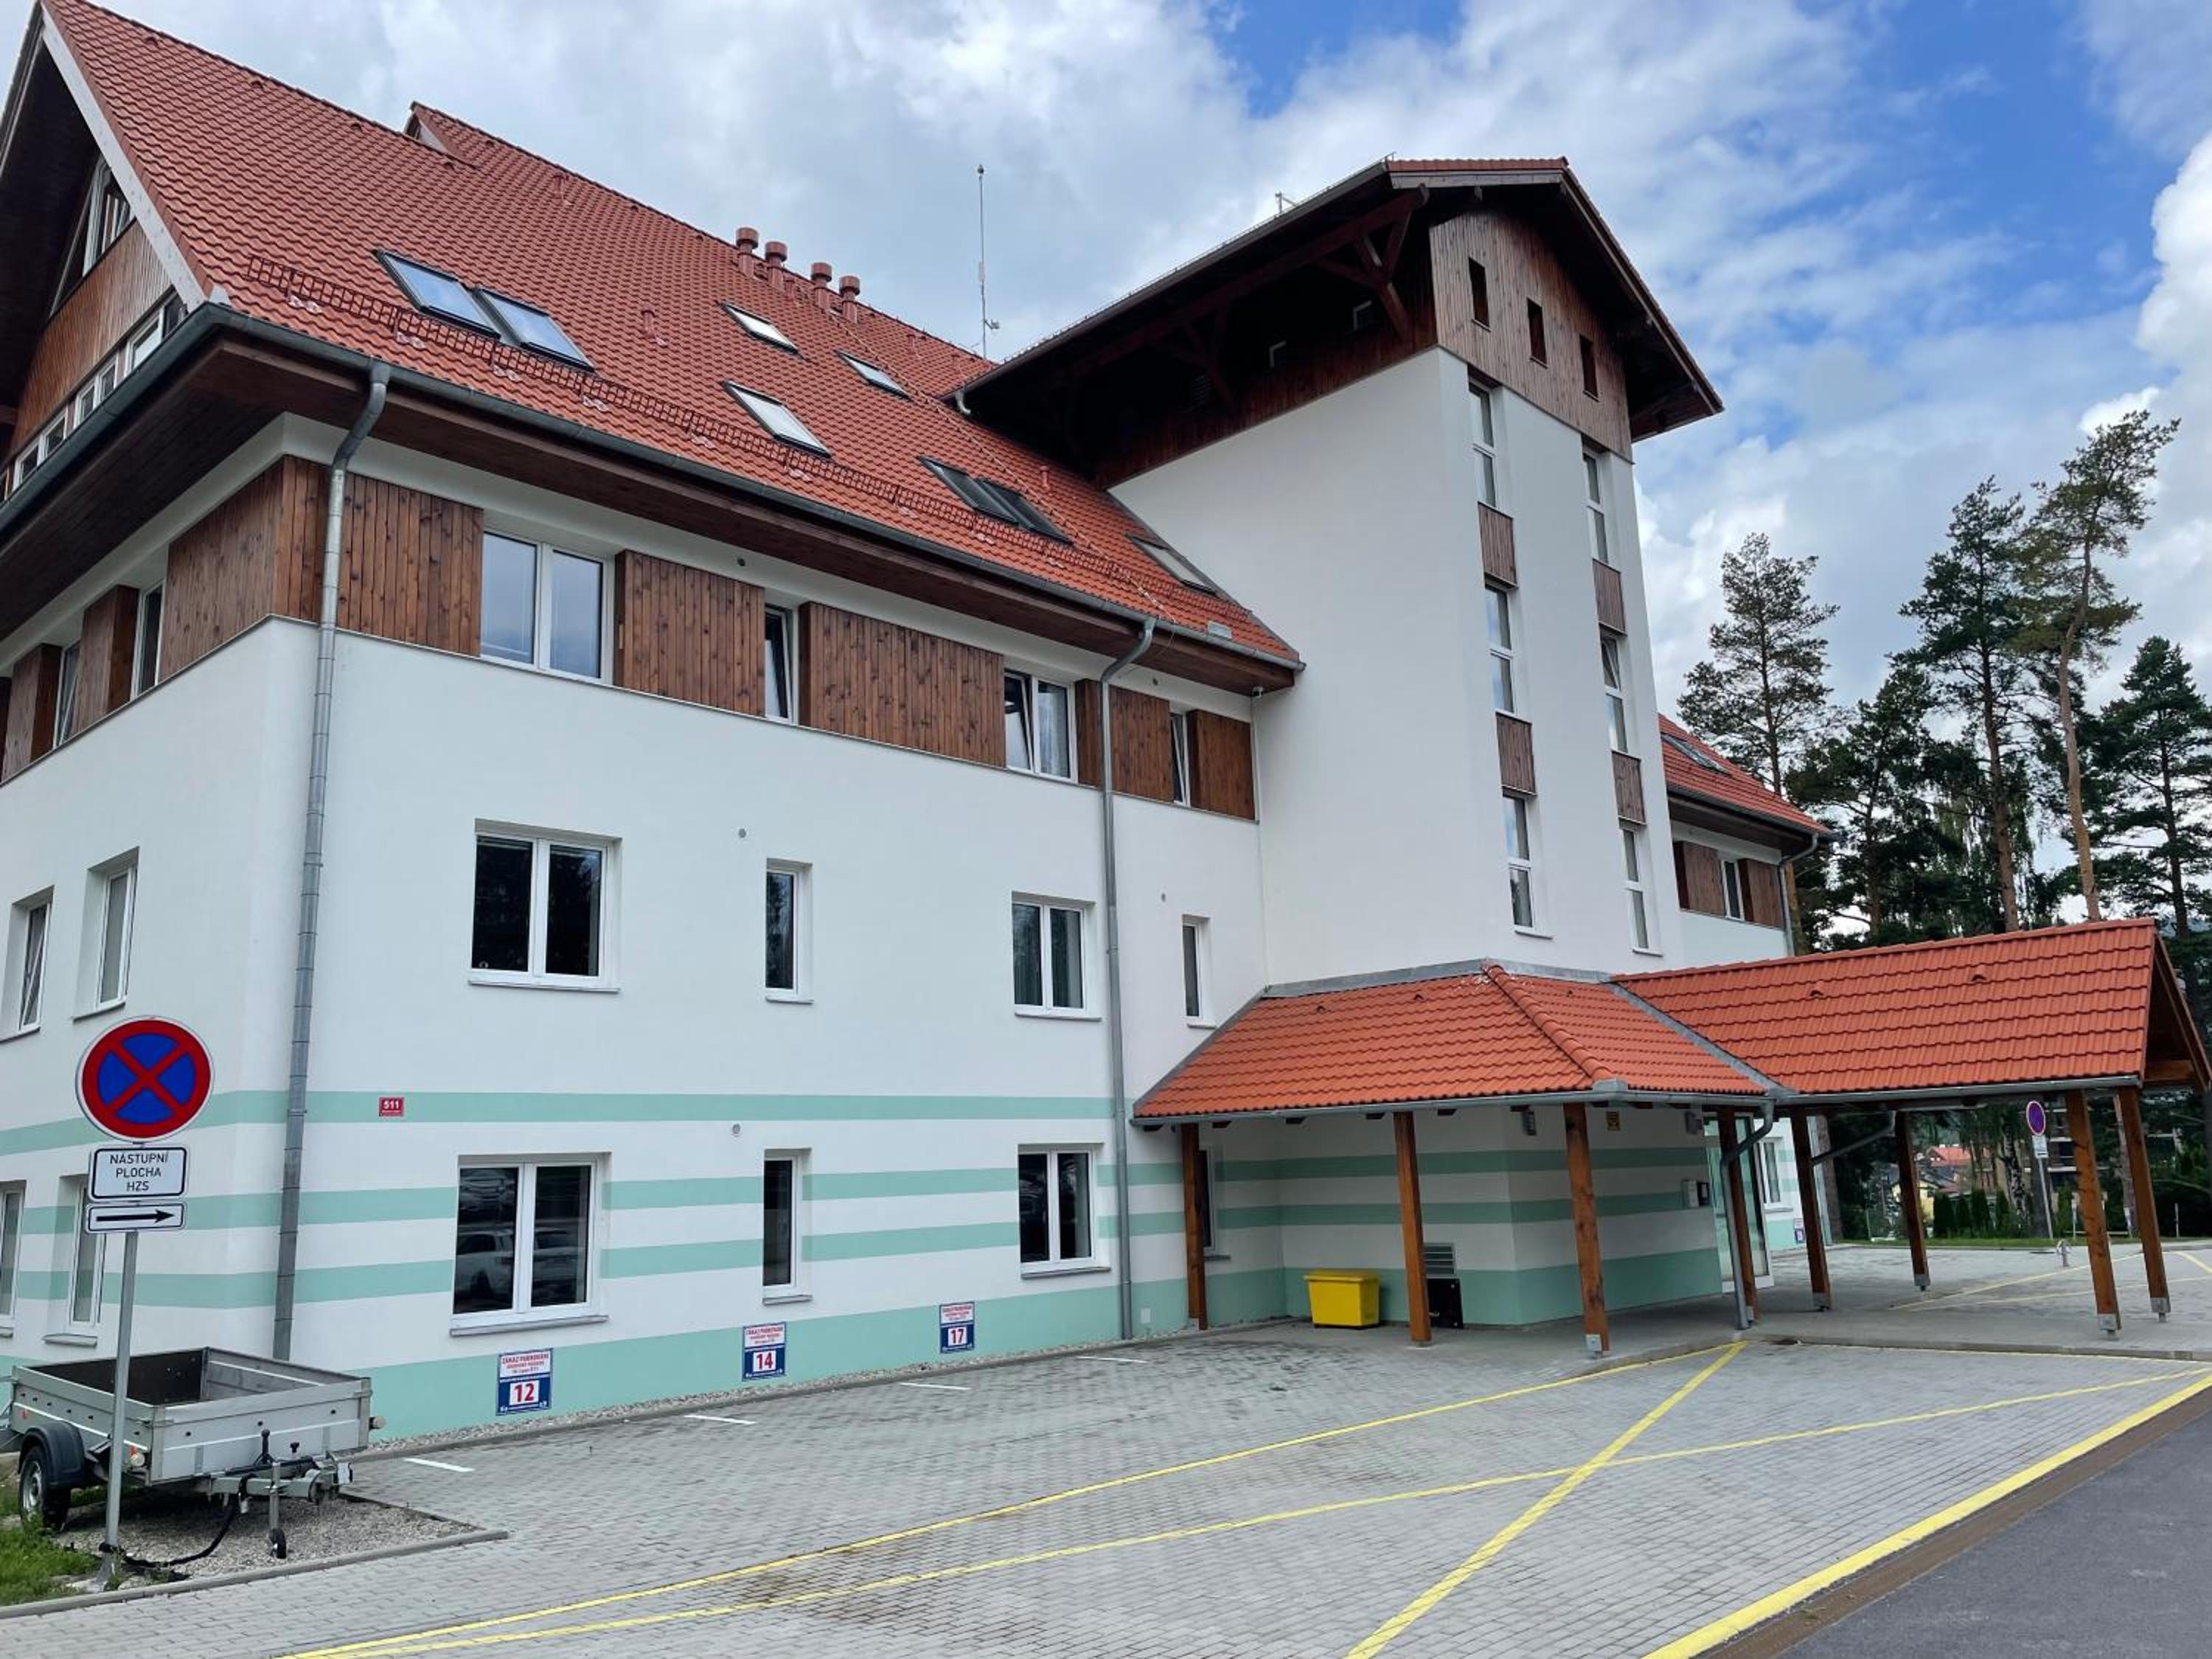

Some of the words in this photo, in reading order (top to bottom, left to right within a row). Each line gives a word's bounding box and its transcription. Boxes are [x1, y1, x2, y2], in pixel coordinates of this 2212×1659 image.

[383, 1100, 399, 1110] 511
[116, 1167, 161, 1178] PLOCHA
[127, 1180, 150, 1192] HZS
[950, 1328, 964, 1344] 17
[757, 1352, 773, 1369] 14
[514, 1382, 535, 1402] 12
